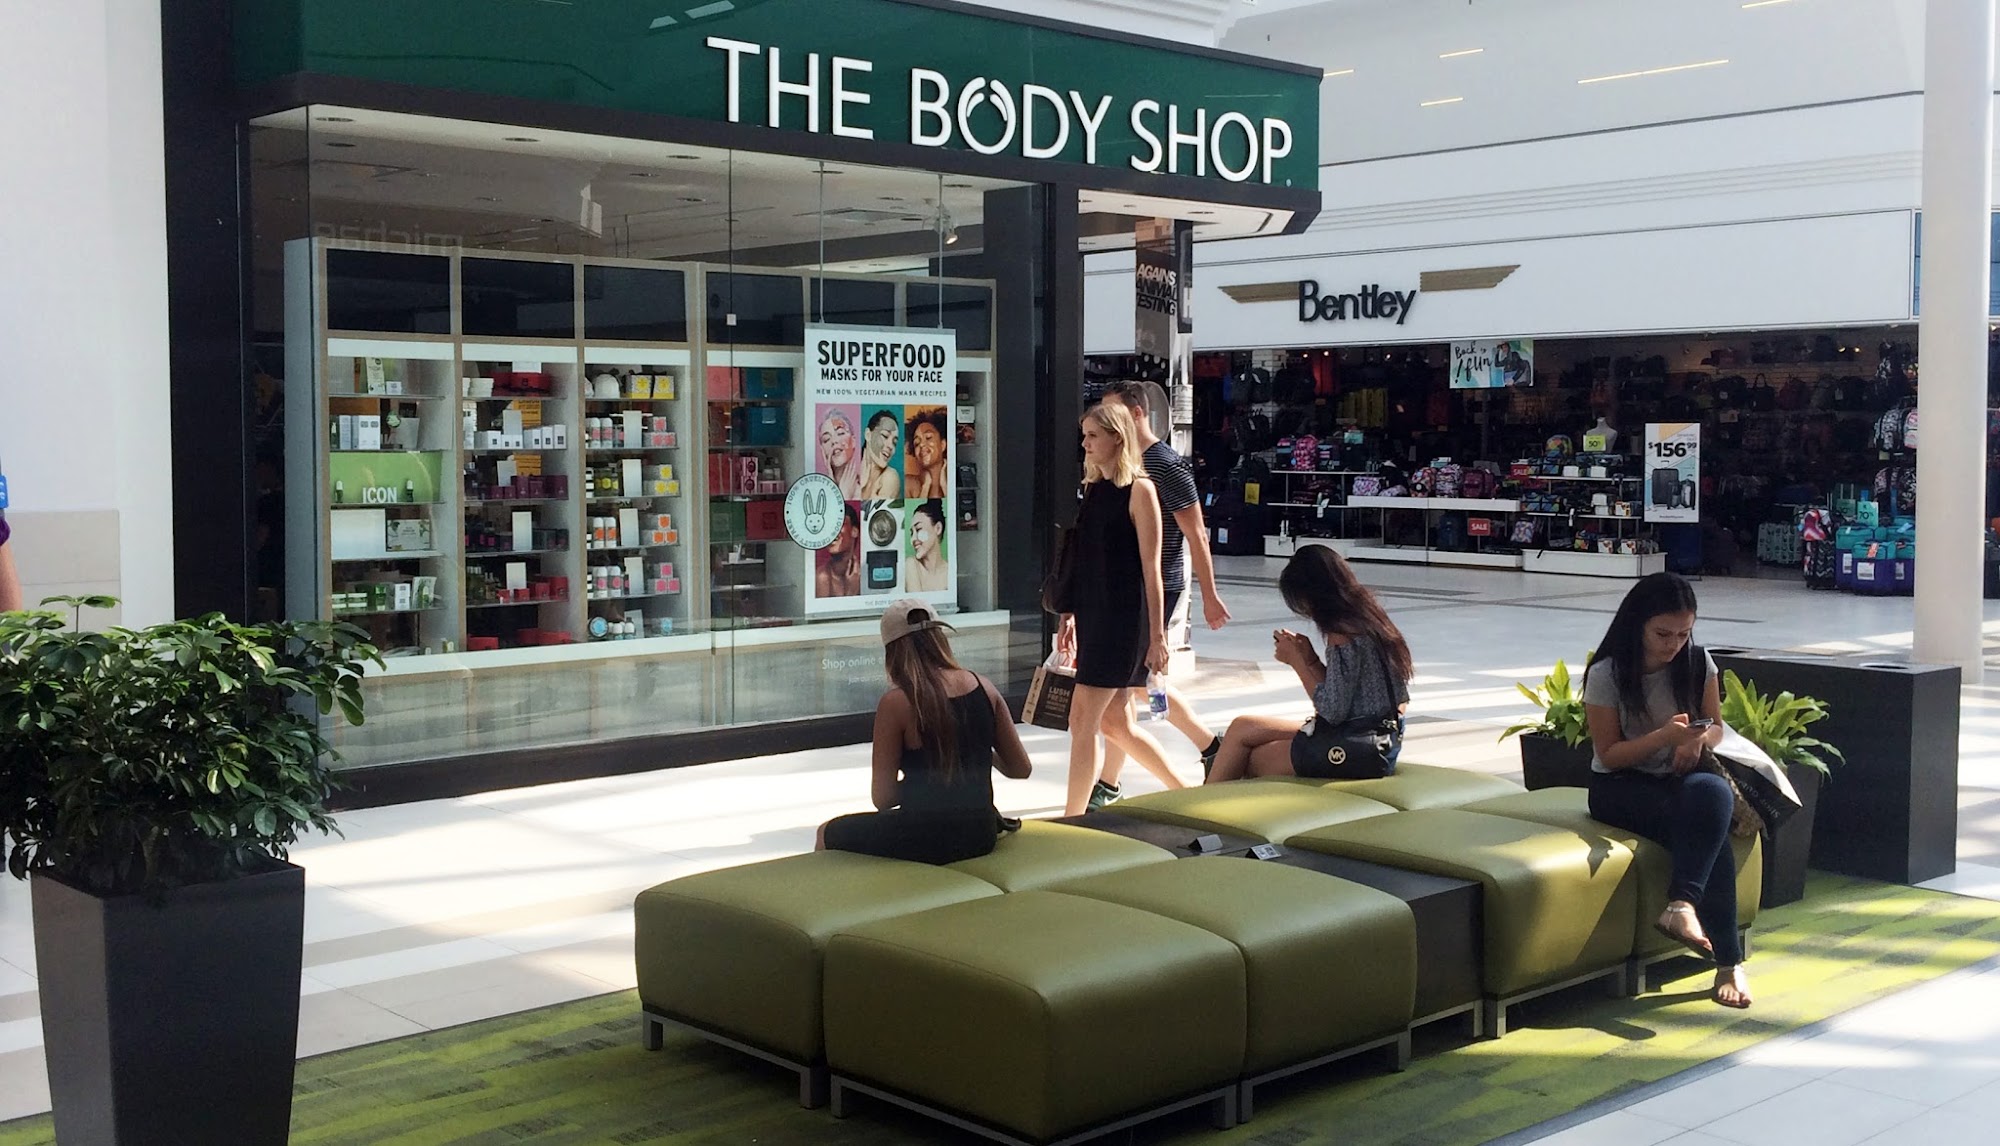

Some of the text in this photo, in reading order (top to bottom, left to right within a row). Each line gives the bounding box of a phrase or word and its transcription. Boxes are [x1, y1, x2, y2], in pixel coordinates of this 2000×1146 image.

[707, 37, 874, 140] THE
[911, 68, 1112, 164] BODY
[1137, 263, 1177, 286] AGAINS
[1299, 280, 1416, 325] Bentley
[818, 340, 946, 368] SUPERFOOD
[821, 368, 943, 382] MASKS FOR YOUR FACE
[362, 487, 397, 504] ICON
[1471, 523, 1488, 531] SALE
[822, 658, 846, 671] Shop
[848, 656, 876, 668] online
[1049, 686, 1070, 697] LUSH
